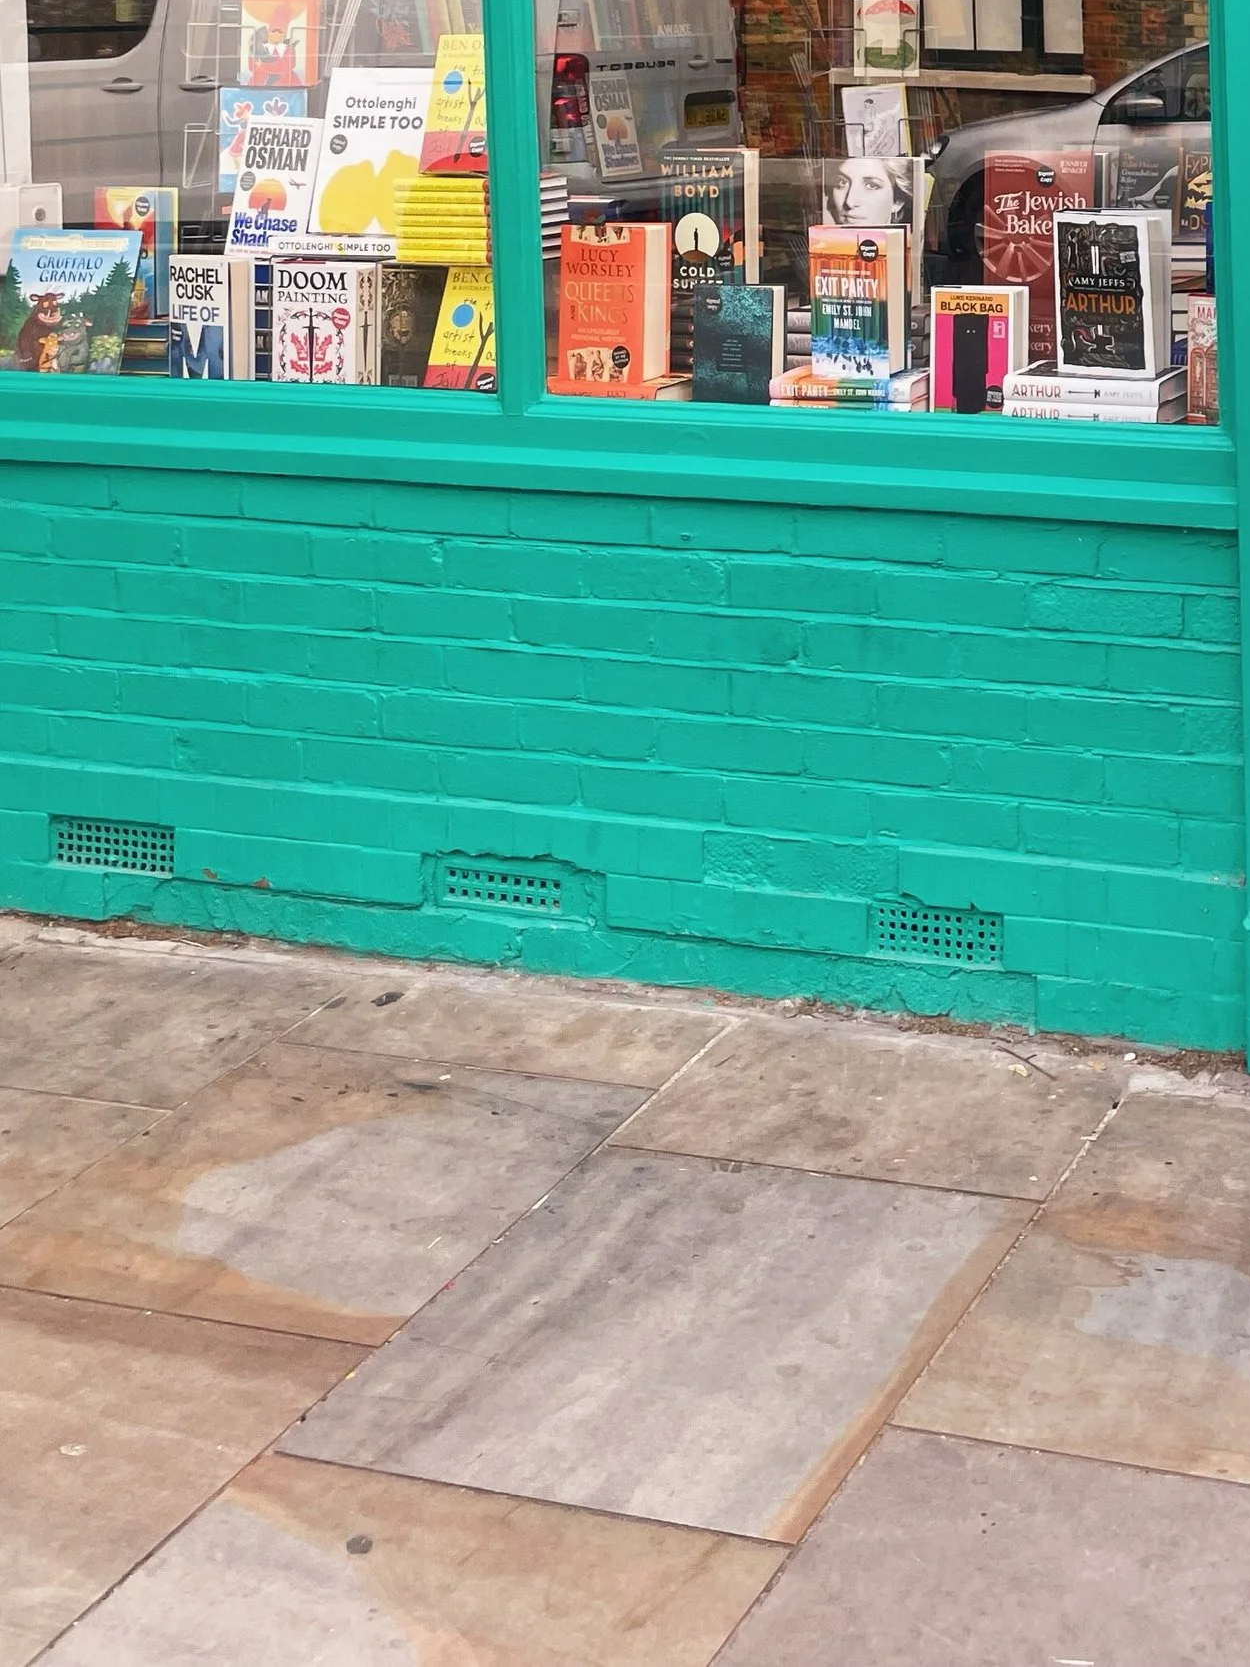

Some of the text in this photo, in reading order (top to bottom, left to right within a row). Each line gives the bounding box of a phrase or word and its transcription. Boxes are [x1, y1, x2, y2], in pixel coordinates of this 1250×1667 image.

[346, 96, 417, 112] Ottolenghi
[332, 114, 424, 131] SIMPLE TOO
[245, 146, 308, 172] OSMAN
[660, 163, 735, 178] WILLIAM
[672, 184, 720, 199] BOYD
[993, 191, 1087, 214] The Jewish
[234, 211, 298, 233] We Chase
[1006, 214, 1054, 235] Bake
[278, 241, 391, 253] OTTOLENGHI SIMPLE TOO
[581, 248, 619, 262] LUCY
[36, 255, 104, 271] GRUFFALO
[566, 261, 635, 277] WORSLEY
[39, 269, 97, 284] GRANNY
[170, 265, 223, 285] RACHEL
[452, 272, 480, 283] BEN
[679, 266, 716, 278] COLD
[278, 269, 348, 291] DOOM
[815, 275, 879, 299] EXIT PARTY
[1074, 277, 1126, 287] AMY JEFFS
[176, 283, 216, 301] CUSK
[277, 290, 349, 304] PAINTING
[822, 303, 872, 317] EMILY ST. JOHN
[940, 301, 1004, 313] BLACK BAG
[1066, 292, 1136, 315] ARTHUR
[172, 304, 221, 323] LIFE OF
[577, 304, 629, 324] KINGS
[833, 318, 861, 331] MANDEL
[443, 328, 475, 342] artist
[801, 385, 829, 398] PARTY
[1011, 384, 1062, 399] ARTHUR
[1104, 390, 1120, 398] AMY
